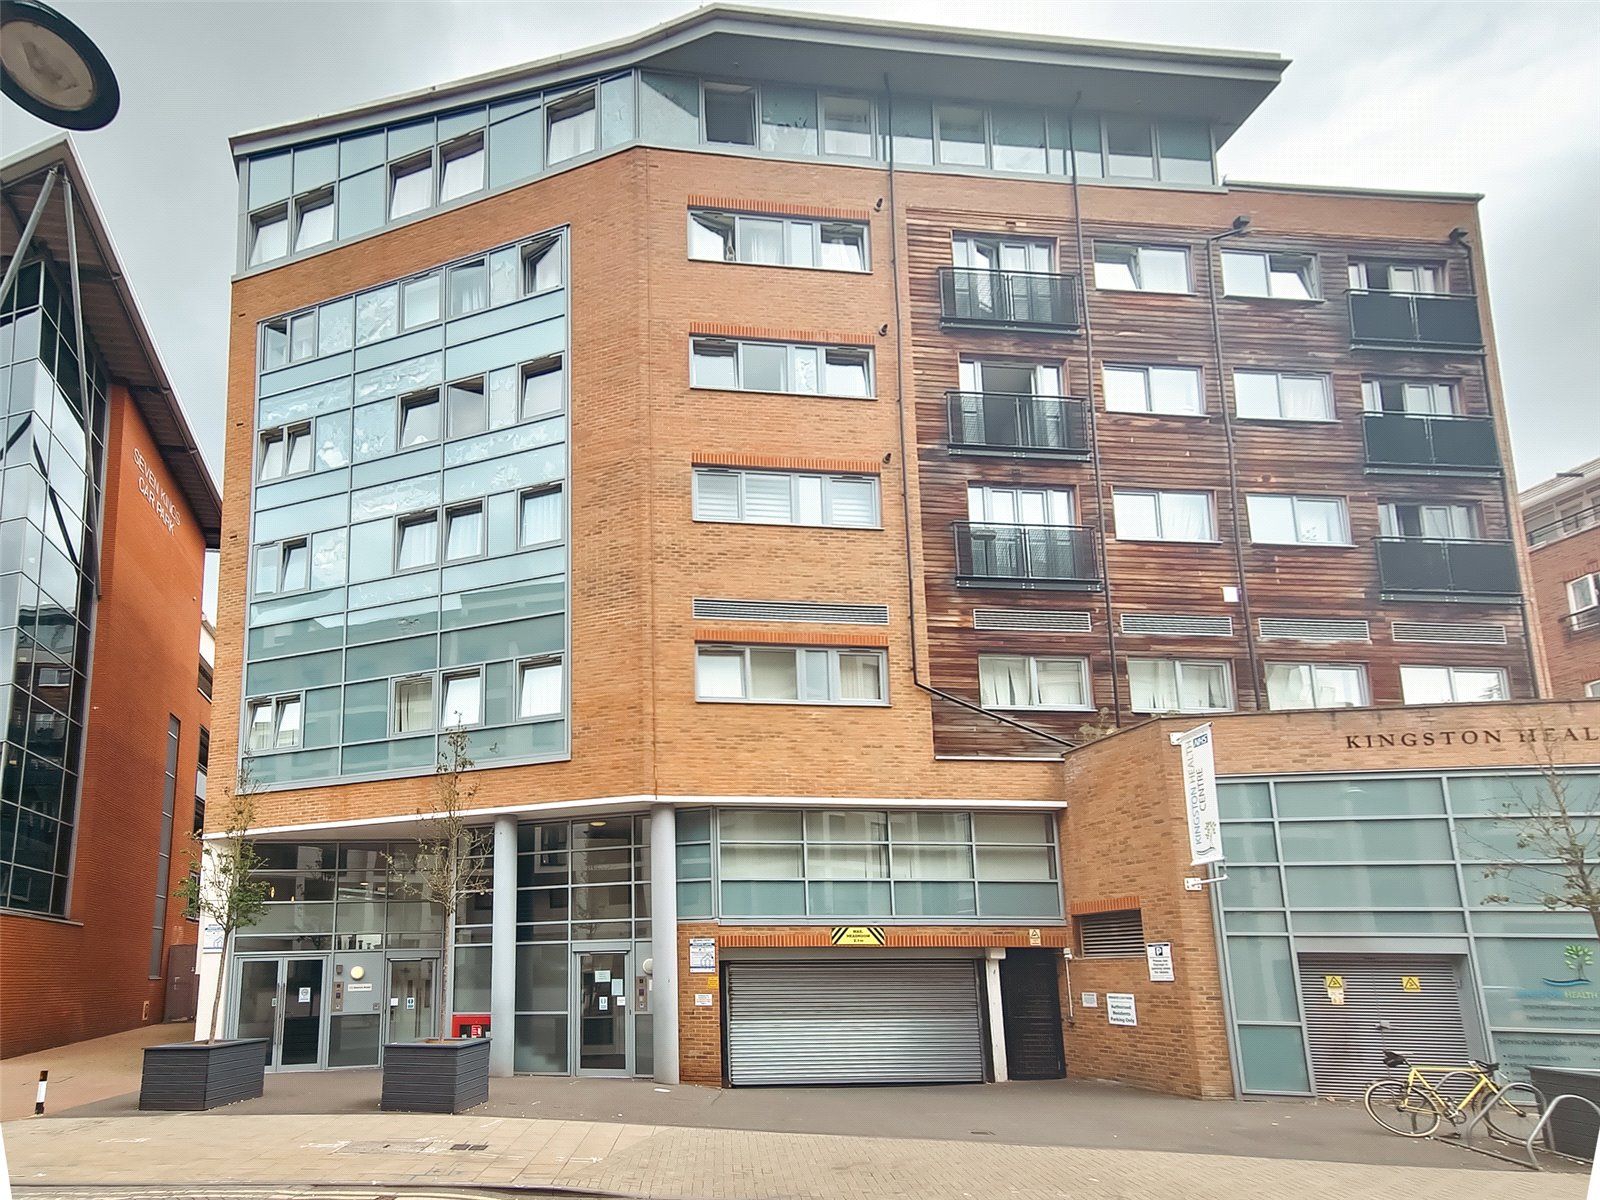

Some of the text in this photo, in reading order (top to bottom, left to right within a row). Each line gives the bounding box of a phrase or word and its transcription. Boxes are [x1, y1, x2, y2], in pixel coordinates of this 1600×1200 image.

[134, 448, 181, 526] SEVEN KINGS
[138, 477, 175, 536] CAR PARK
[1345, 729, 1501, 749] KINGSTON
[1185, 740, 1202, 845] KINGSTON HEALTH
[1196, 767, 1206, 812] CENTRE
[1565, 991, 1599, 999] HEALTH
